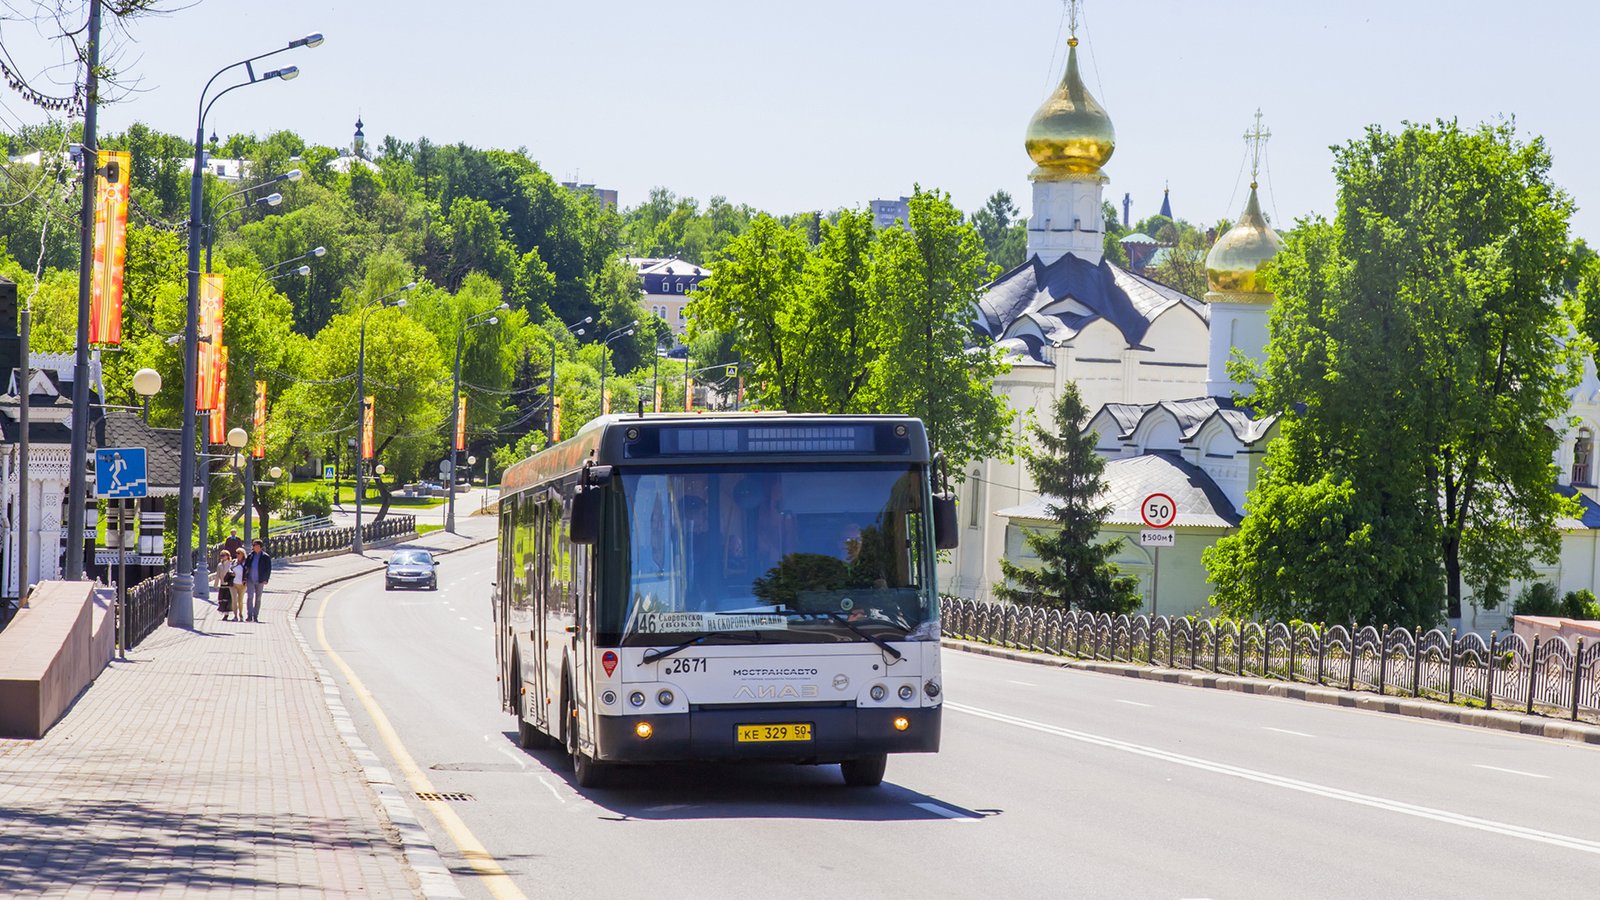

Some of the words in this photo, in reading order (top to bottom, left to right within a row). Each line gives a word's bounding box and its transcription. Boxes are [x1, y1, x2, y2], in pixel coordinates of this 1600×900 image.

[1149, 504, 1169, 518] 50
[639, 614, 656, 634] 46
[707, 619, 717, 631] НА
[673, 658, 707, 673] 2671
[733, 668, 818, 676] МОСТРАНСАВТО
[734, 684, 819, 698] ЛИАЗ
[744, 730, 759, 740] КЕ
[764, 727, 788, 739] 329
[794, 725, 807, 735] 50
